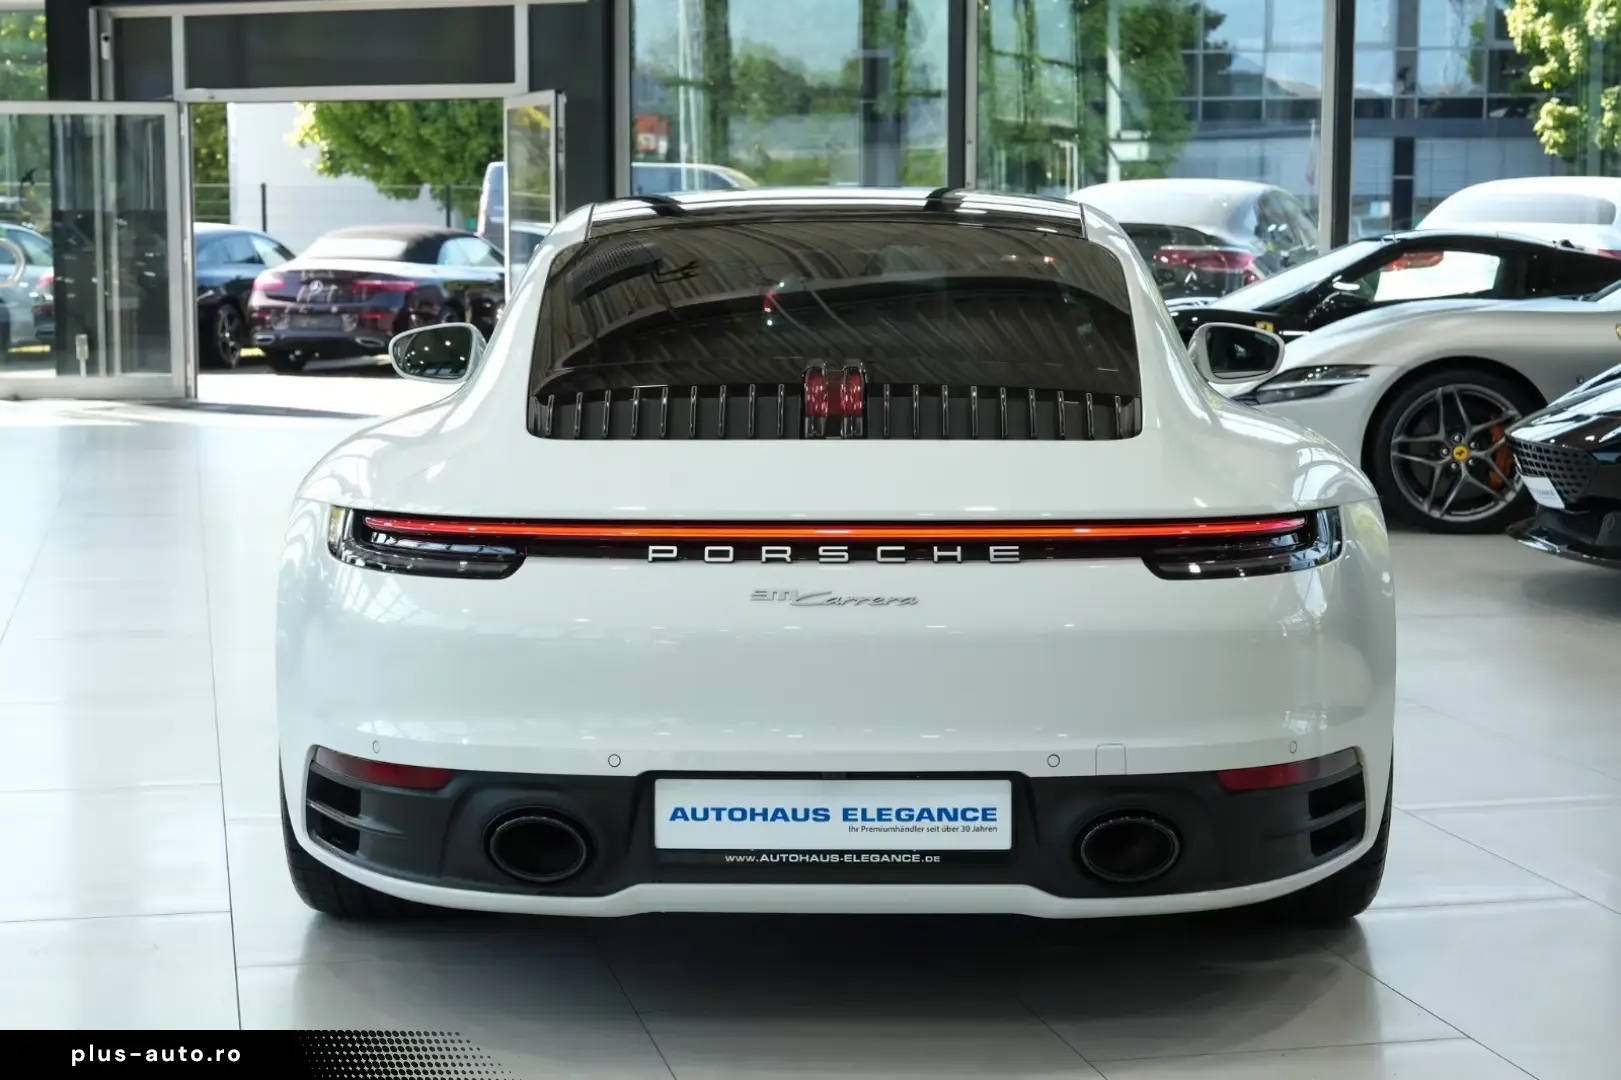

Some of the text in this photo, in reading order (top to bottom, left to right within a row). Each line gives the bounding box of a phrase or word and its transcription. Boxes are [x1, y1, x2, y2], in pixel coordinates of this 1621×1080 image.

[647, 545, 1020, 562] PORSCHE
[789, 591, 919, 607] Carrera
[669, 807, 998, 823] AUTOHAUS ELEGANCE
[848, 824, 998, 833] Ihr Premiumhändler seit über 30 Jahren
